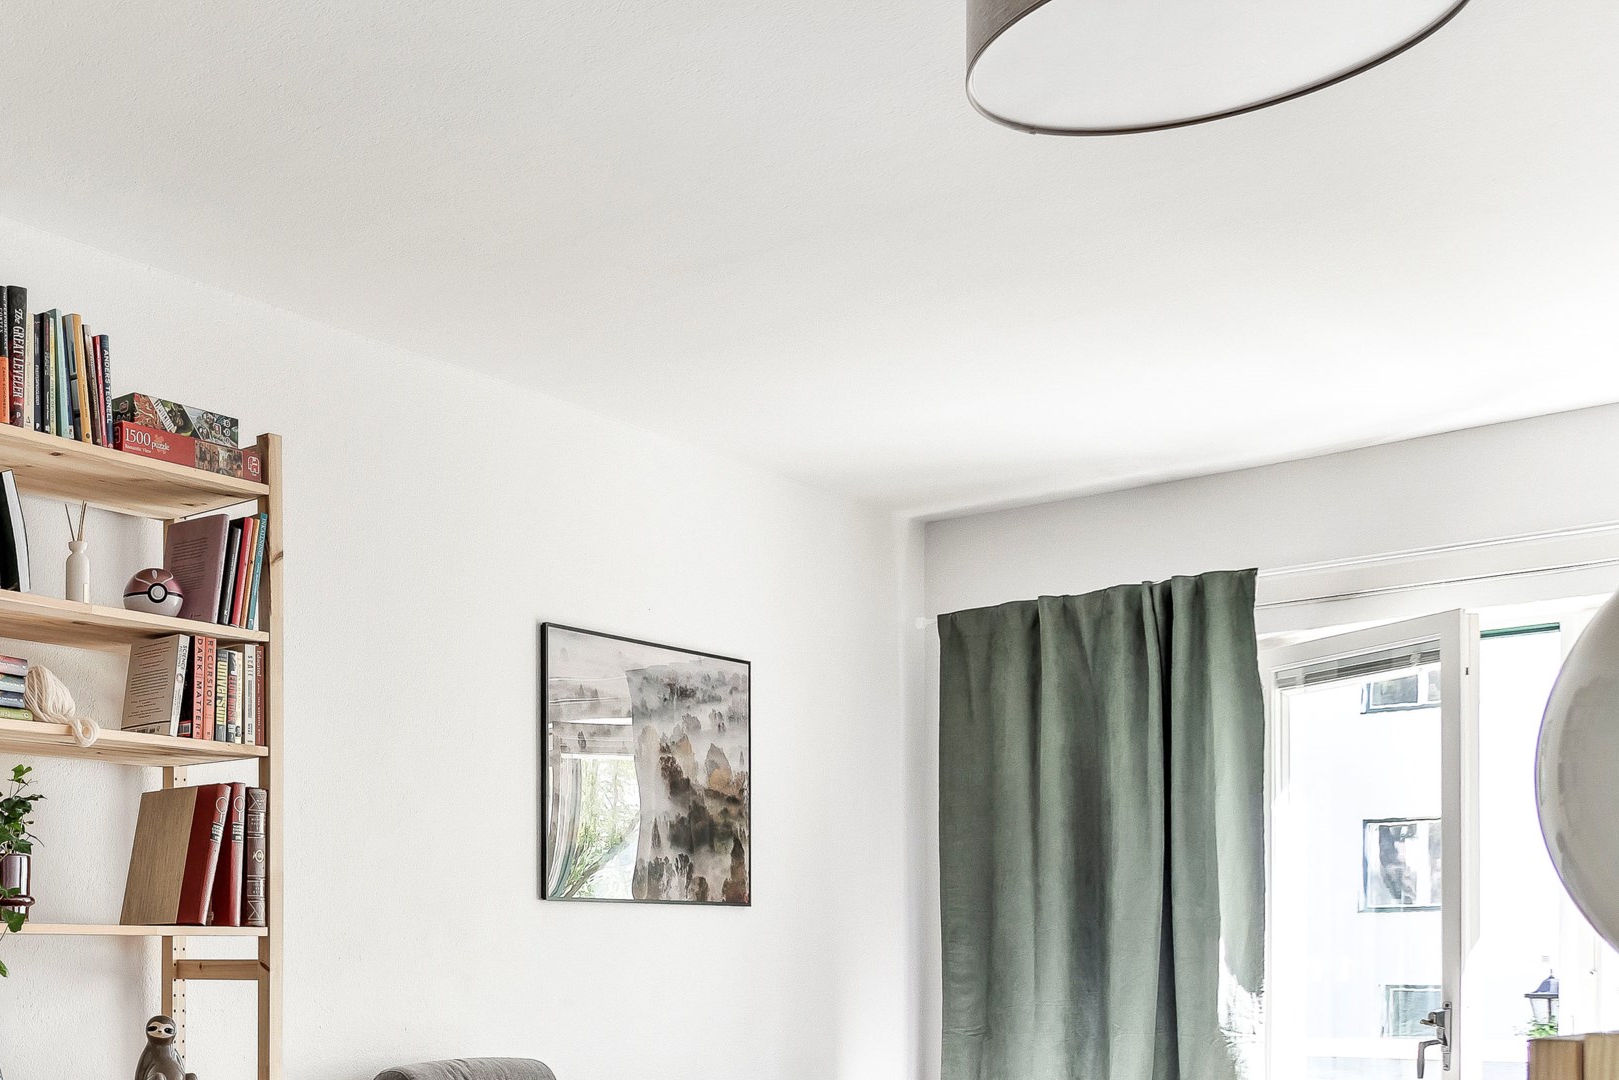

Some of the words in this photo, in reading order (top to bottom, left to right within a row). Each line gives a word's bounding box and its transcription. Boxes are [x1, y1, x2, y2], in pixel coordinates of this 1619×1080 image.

[14, 309, 23, 324] The
[13, 326, 24, 354] GREAT
[13, 357, 24, 398] LEVELER
[103, 350, 111, 384] ANDERS
[125, 428, 150, 446] 1500
[152, 440, 169, 451] puzzle
[216, 661, 226, 725] universum
